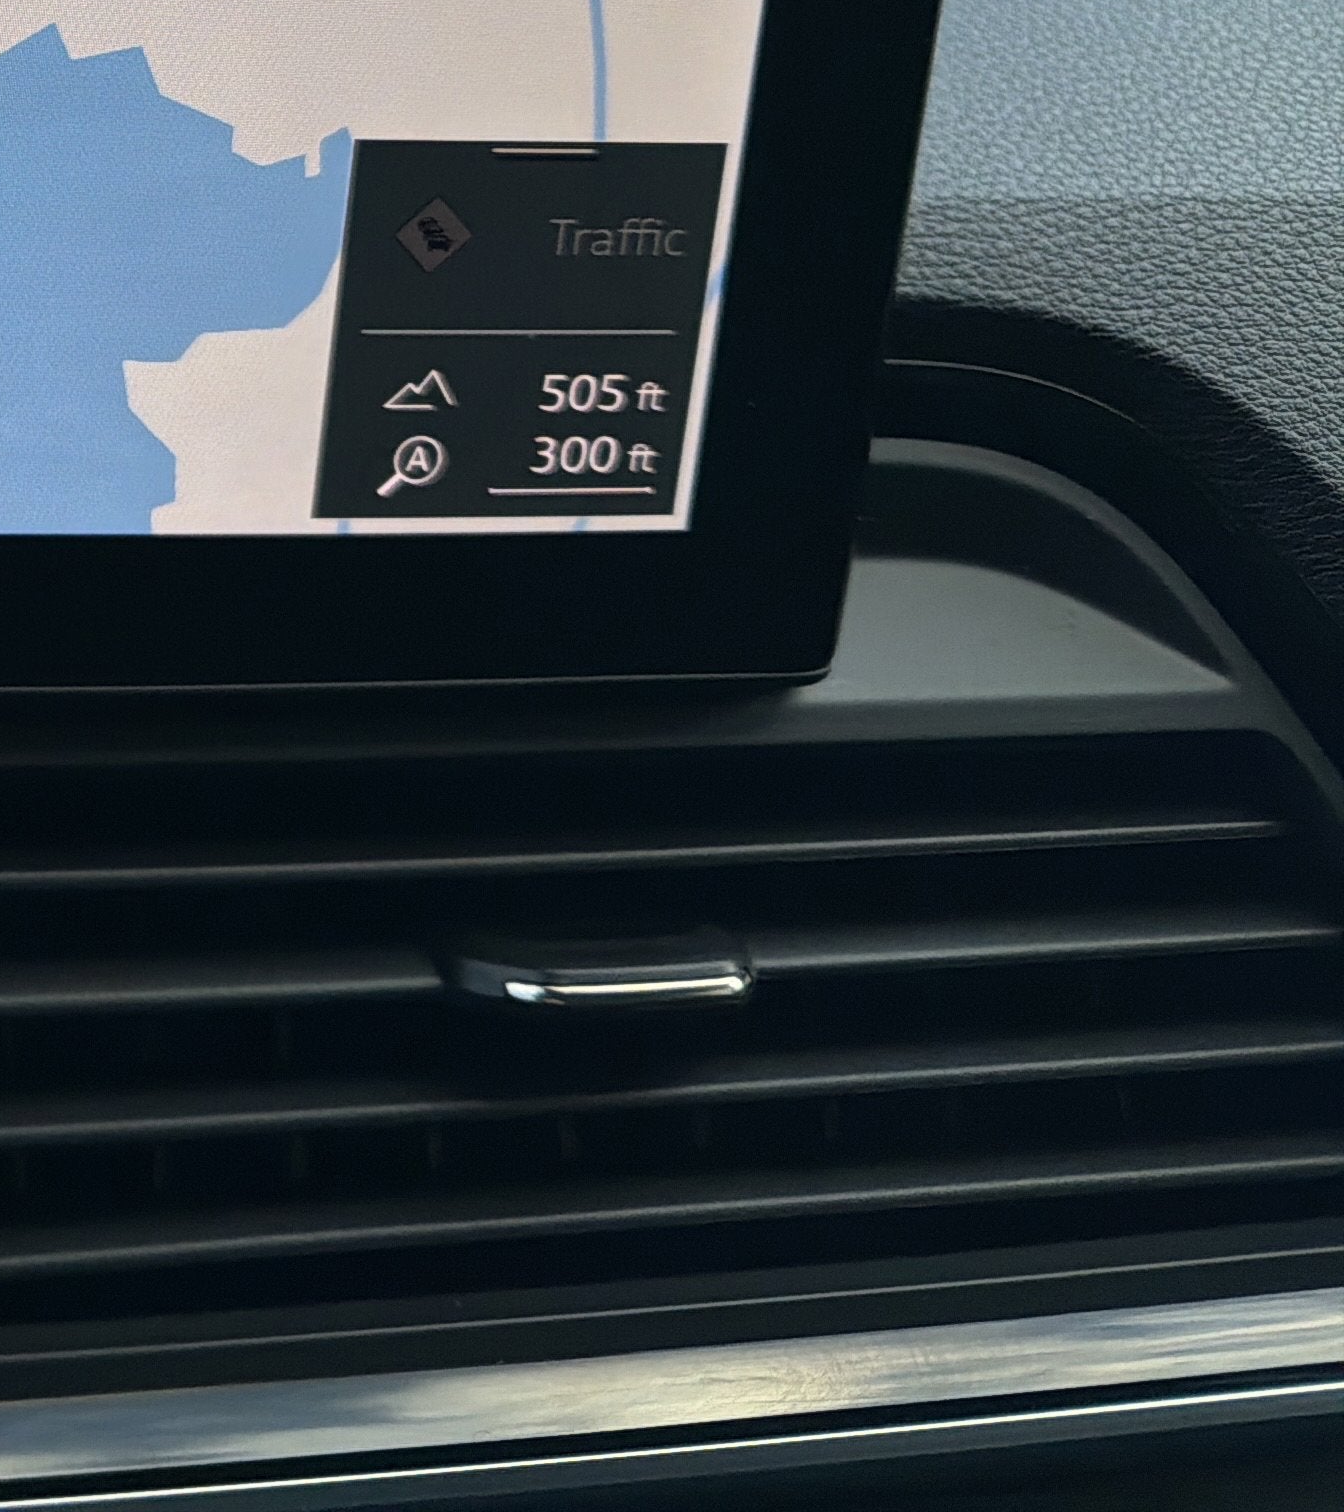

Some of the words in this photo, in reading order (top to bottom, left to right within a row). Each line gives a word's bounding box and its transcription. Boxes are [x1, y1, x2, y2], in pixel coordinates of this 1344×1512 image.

[549, 217, 688, 258] Traffic
[538, 373, 630, 413] 505
[635, 381, 670, 412] ft
[405, 446, 430, 472] A
[528, 435, 622, 475] 300
[626, 443, 662, 474] ft
